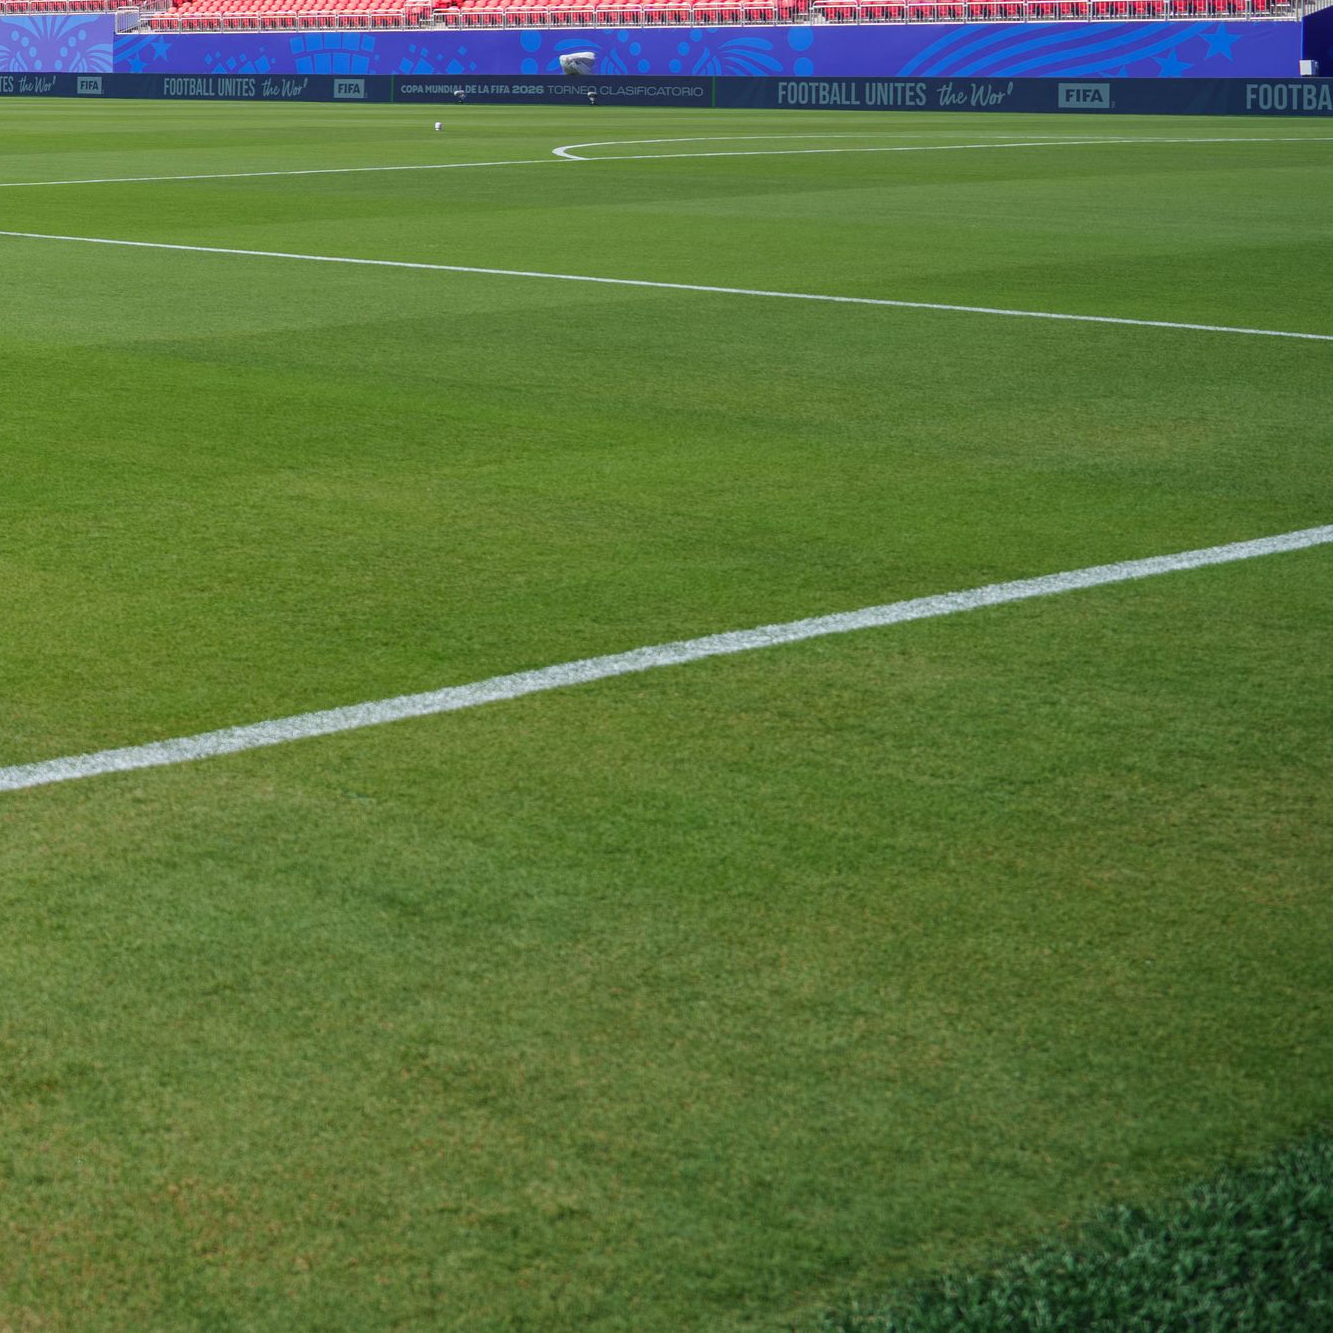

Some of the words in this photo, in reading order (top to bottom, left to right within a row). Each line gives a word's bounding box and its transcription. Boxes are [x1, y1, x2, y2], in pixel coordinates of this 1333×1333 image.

[17, 75, 34, 93] the
[79, 79, 99, 91] FIFA
[163, 77, 215, 96] FOOTBALL
[217, 77, 256, 97] UNITES
[260, 77, 281, 97] the
[337, 83, 361, 95] FIFA
[400, 84, 424, 94] COPA
[465, 84, 477, 94] DE
[477, 84, 490, 94] LA
[491, 84, 510, 94] FIFA
[511, 84, 545, 95] 2026
[547, 84, 598, 96] TORNEO
[599, 85, 704, 97] CLASIFICATORIO
[778, 82, 861, 106] FOOTBALL
[864, 82, 927, 107] UNITES
[936, 81, 968, 107] the
[1064, 88, 1104, 103] FIFA
[1246, 83, 1333, 111] FOOTBA
